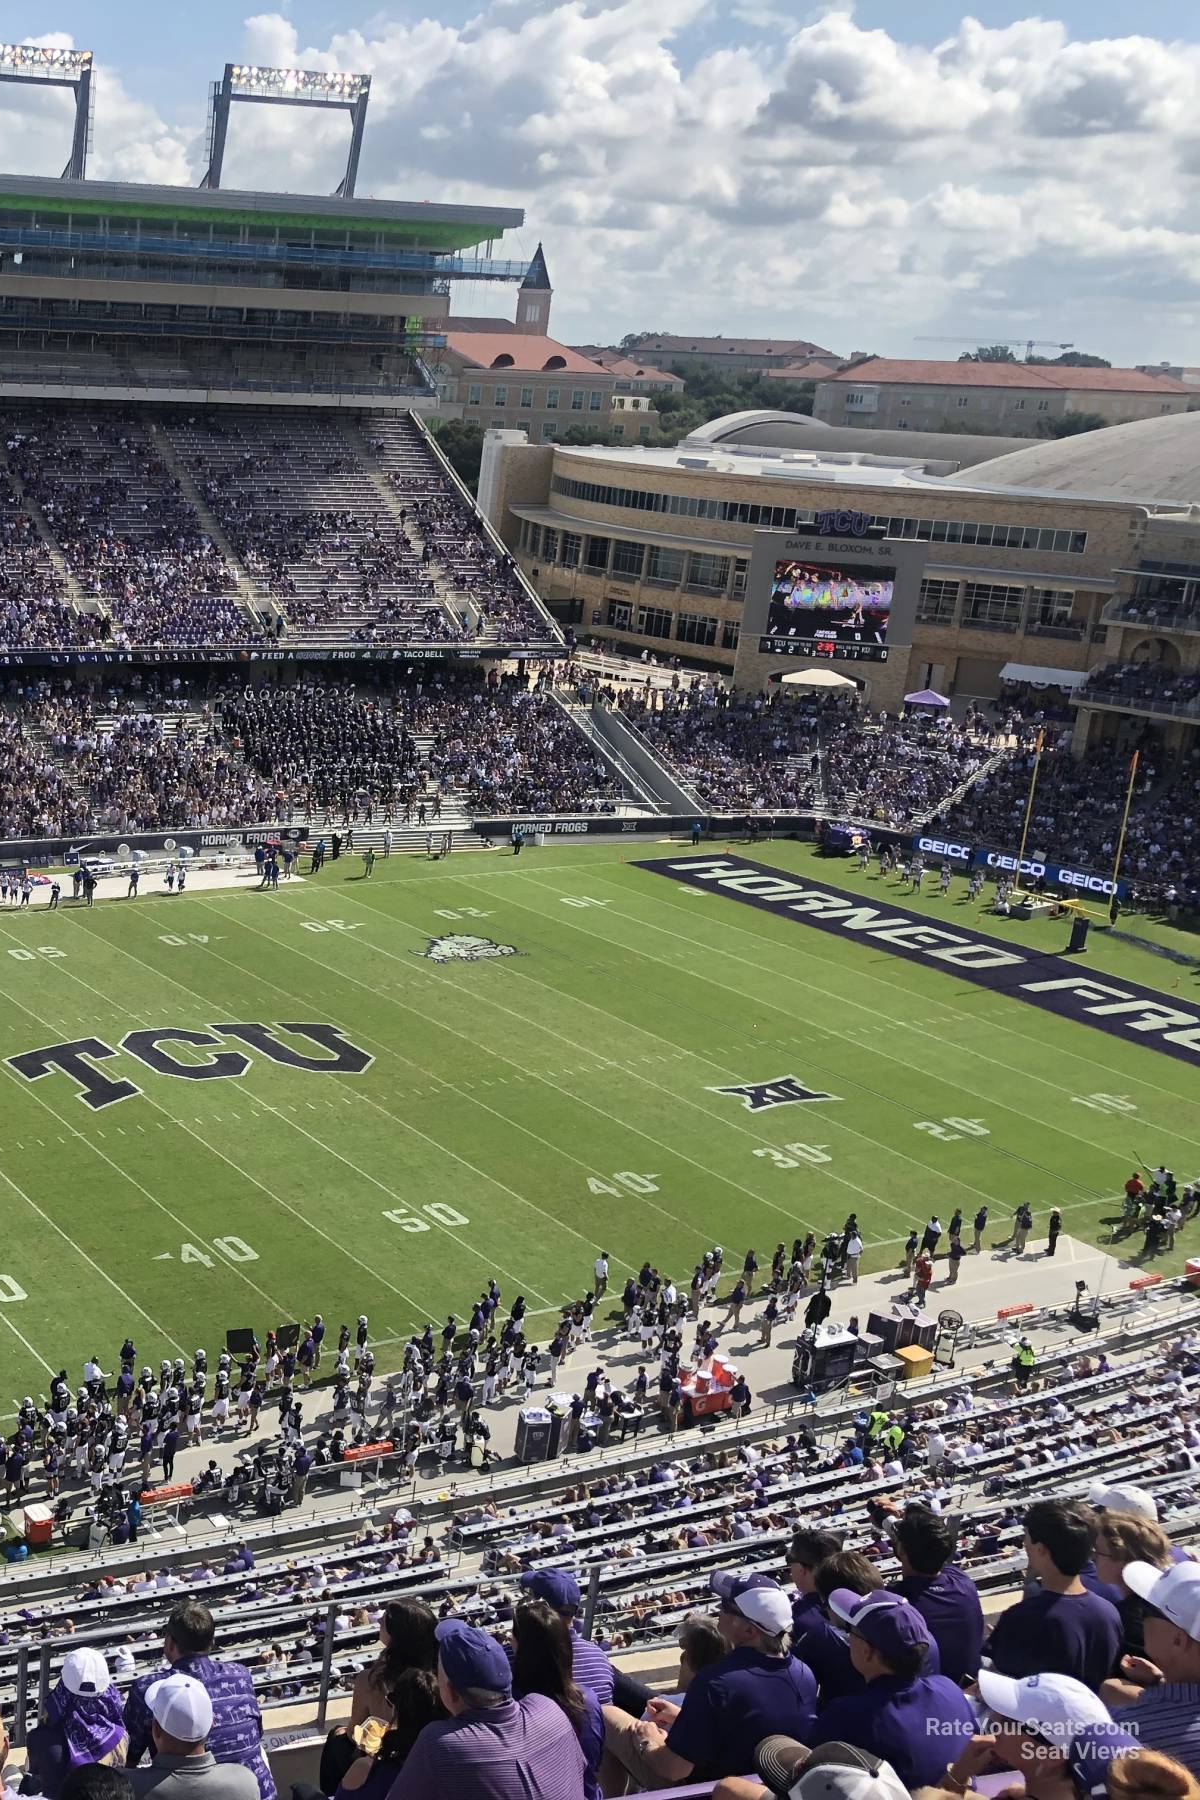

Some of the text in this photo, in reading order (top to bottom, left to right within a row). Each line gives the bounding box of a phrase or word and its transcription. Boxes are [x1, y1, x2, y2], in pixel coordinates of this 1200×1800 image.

[818, 511, 871, 536] TCU
[785, 540, 812, 551] DAVE
[201, 832, 243, 847] HORNED
[243, 830, 281, 844] FROGS
[511, 821, 588, 834] HORNED FROGS
[986, 852, 1046, 878] GEICO
[1058, 869, 1118, 895] GEICO
[668, 860, 1028, 969] HORNED
[7, 945, 69, 961] 50
[1, 1021, 377, 1112] TCU
[912, 1117, 985, 1142] 20
[752, 1142, 826, 1169] 30
[586, 1170, 658, 1199] 40
[381, 1202, 470, 1233] 50
[180, 1236, 260, 1269] 40
